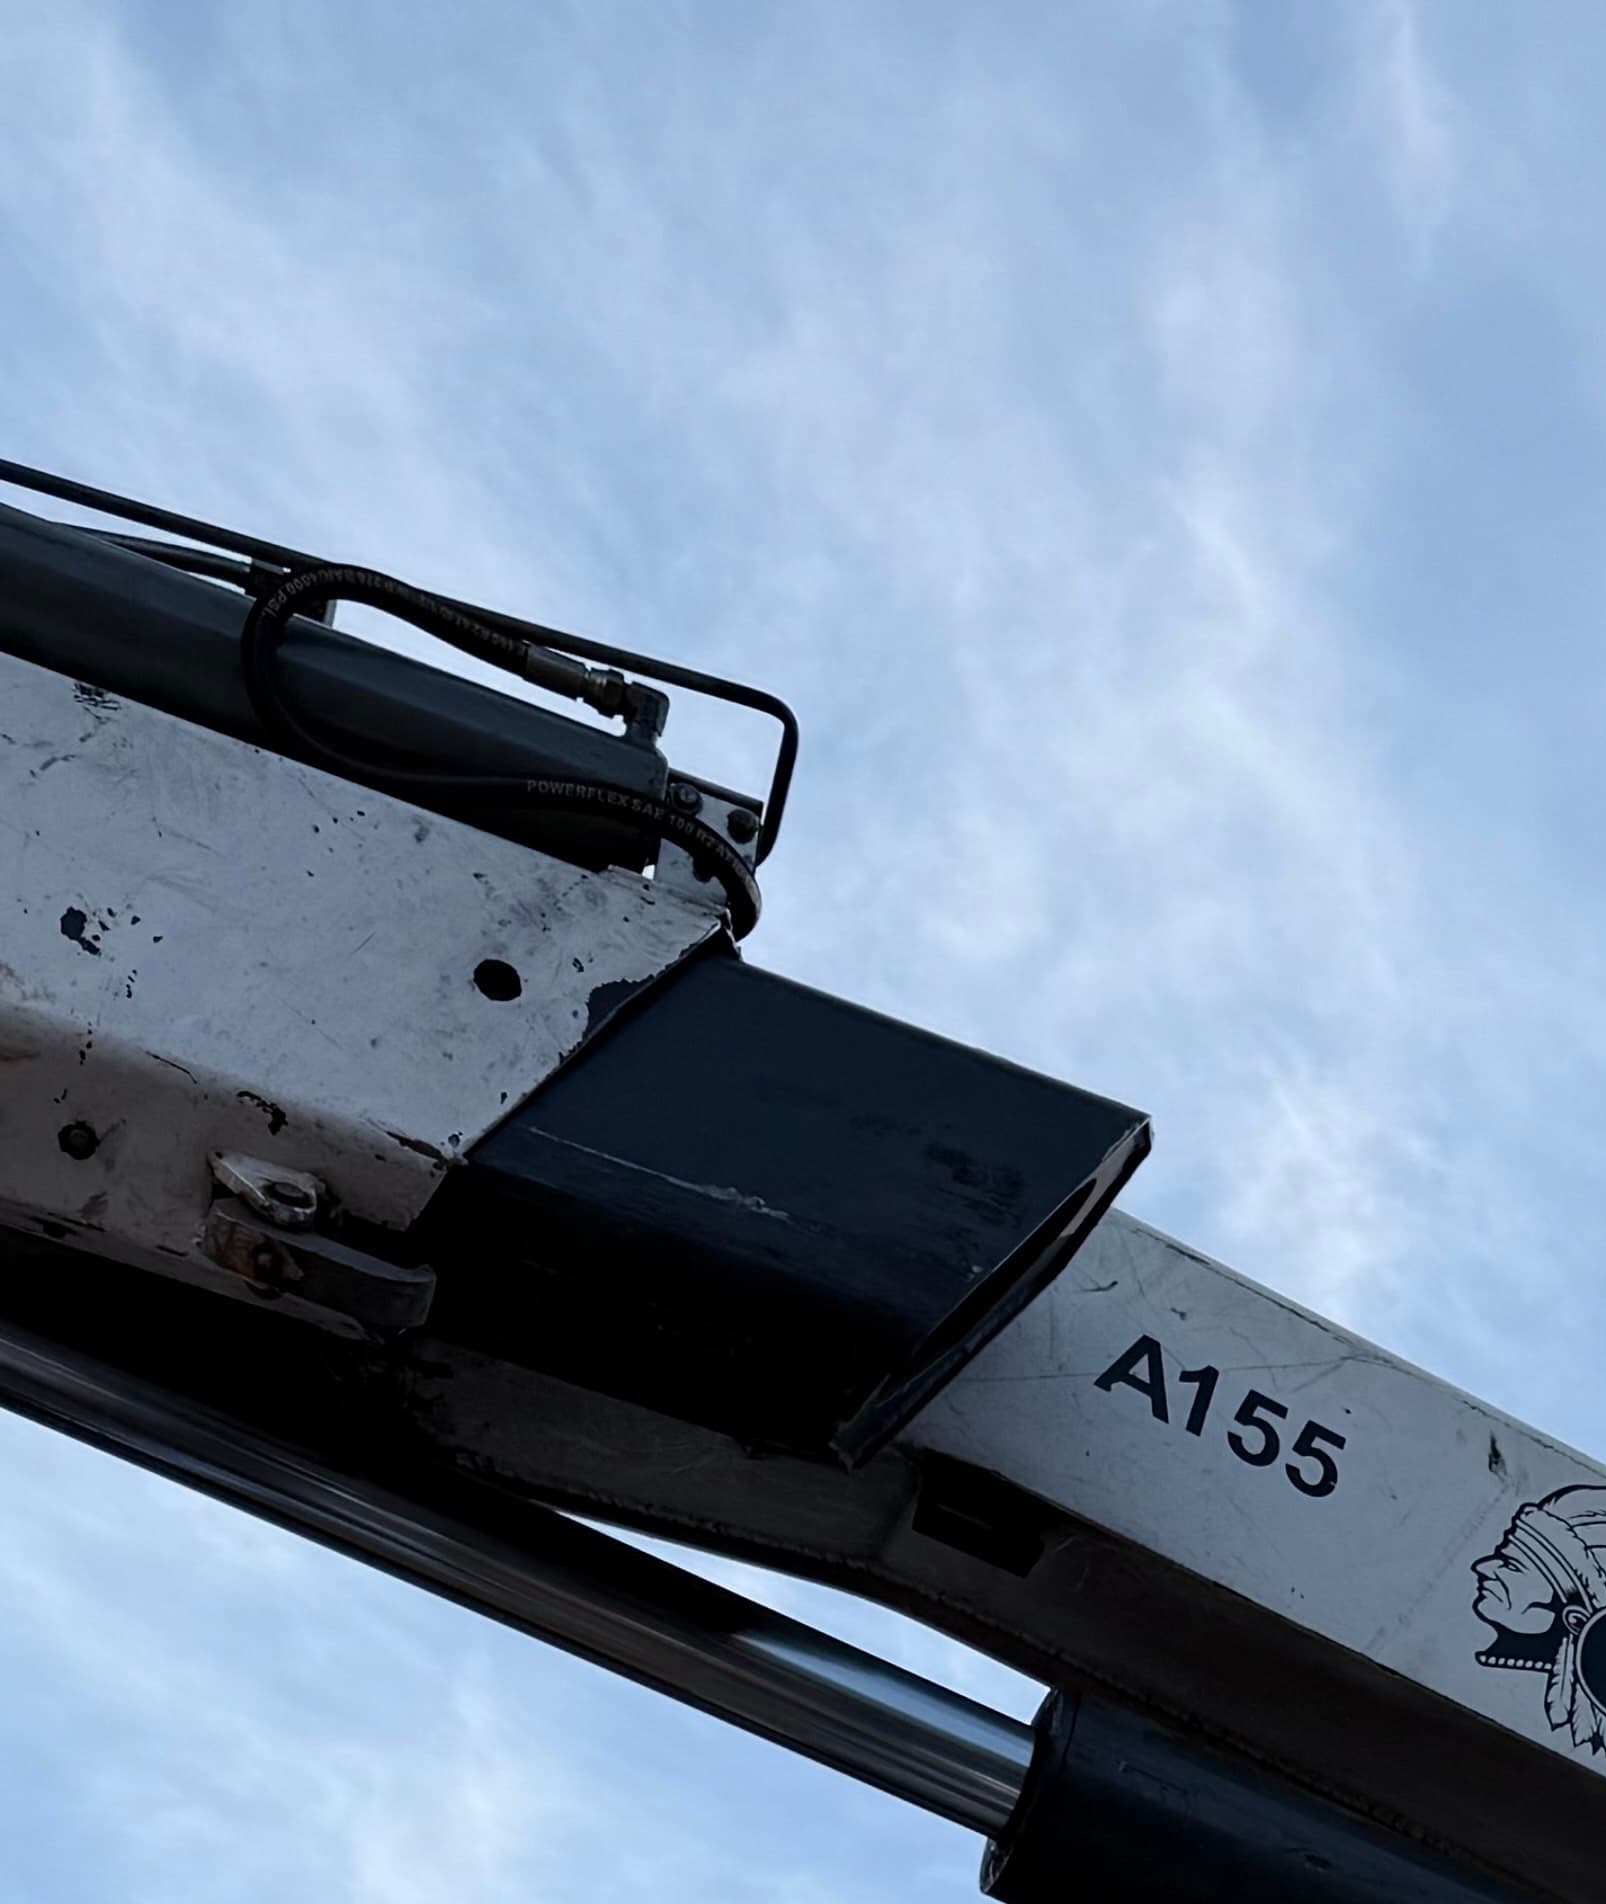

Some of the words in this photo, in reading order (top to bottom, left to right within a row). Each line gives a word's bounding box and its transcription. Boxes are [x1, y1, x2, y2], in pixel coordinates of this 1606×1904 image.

[527, 779, 628, 807] POWERFLEX
[629, 798, 666, 819] SAE
[669, 815, 692, 834] 100
[1094, 1334, 1347, 1498] A155
